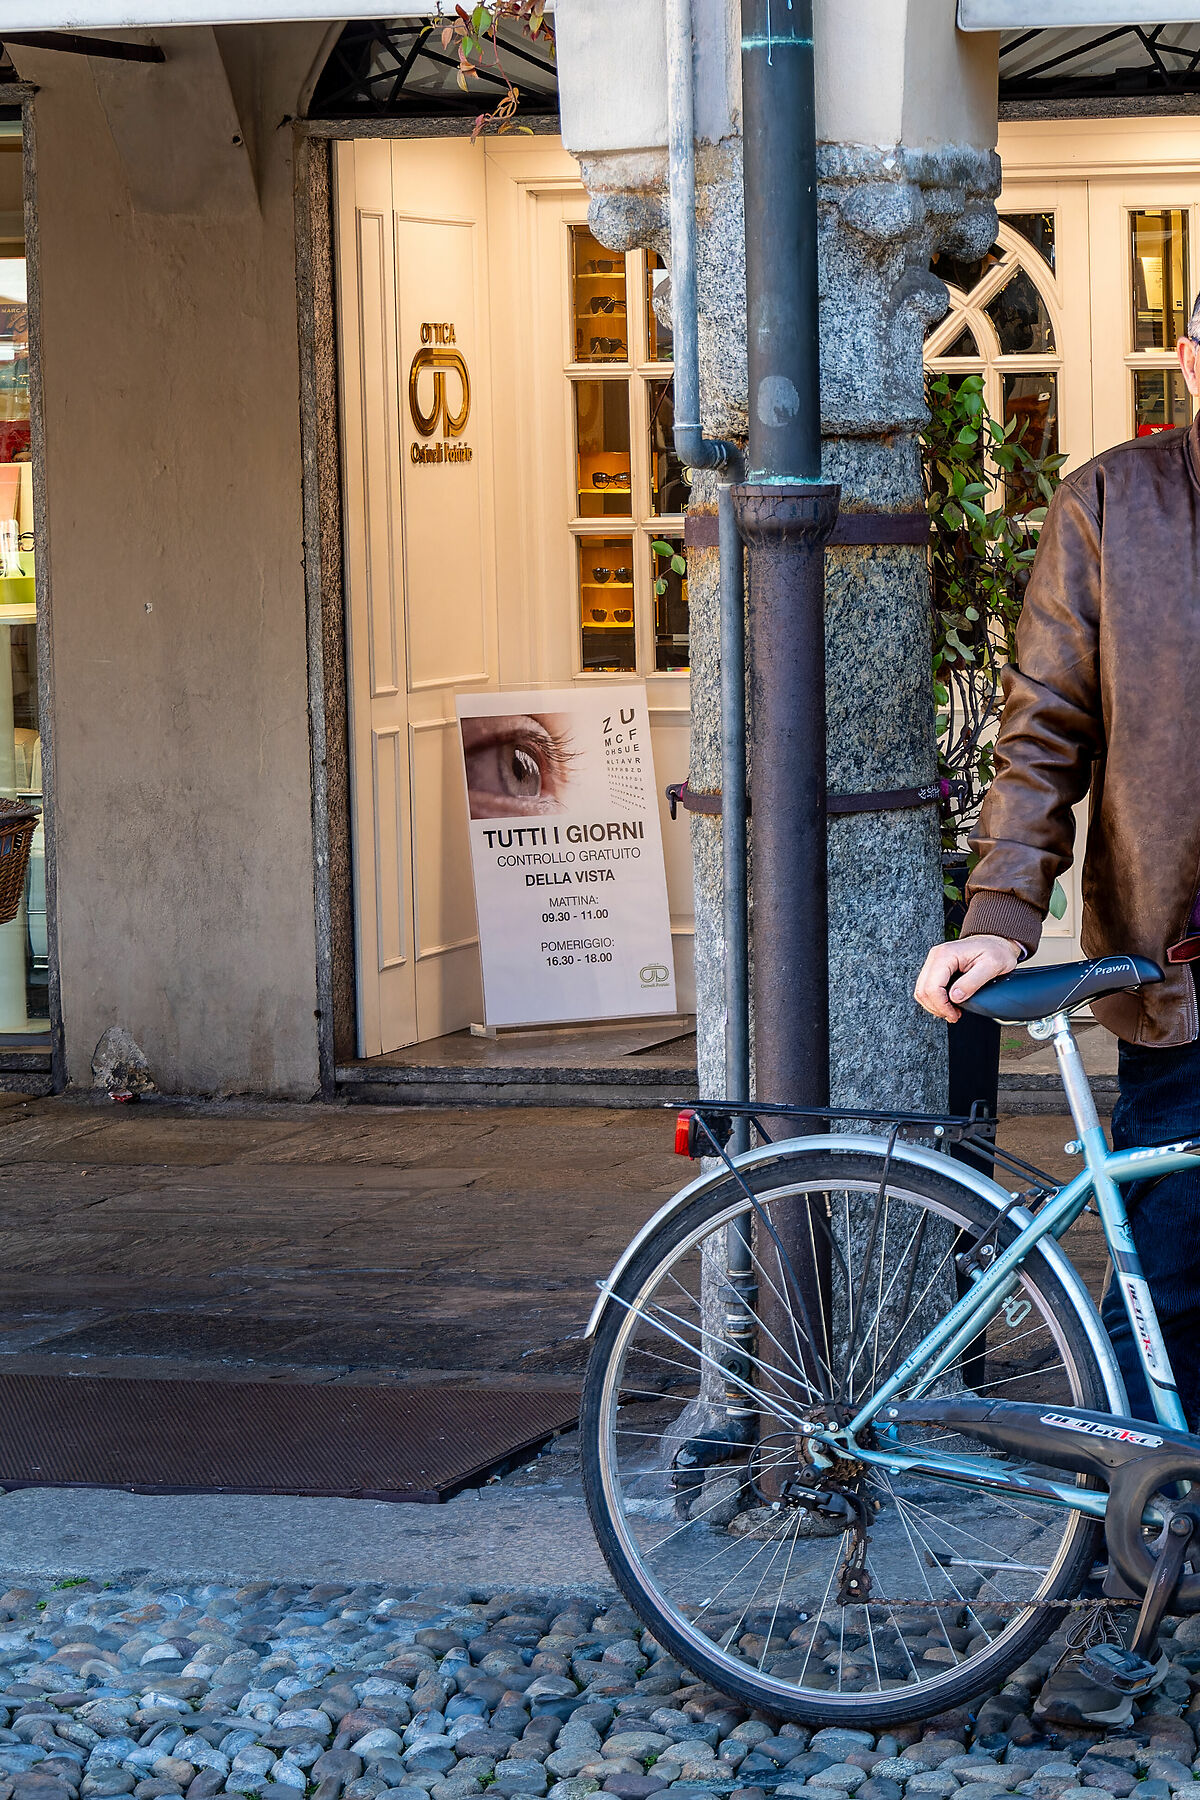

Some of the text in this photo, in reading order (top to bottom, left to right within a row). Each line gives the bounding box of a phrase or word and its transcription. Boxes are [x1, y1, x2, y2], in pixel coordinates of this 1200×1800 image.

[420, 322, 456, 344] OTTICA
[410, 442, 443, 464] Ostinelli
[482, 821, 645, 849] TUTTI I GIORNI
[497, 847, 641, 867] CONTROLLO GRATUITO
[525, 869, 616, 887] DELLA VISTA
[549, 895, 599, 908] MATTINA:
[541, 911, 571, 923] 09.30
[580, 909, 609, 921] 11.00
[541, 937, 615, 952] POMERIGGIO:
[546, 955, 574, 967] 16.30
[584, 952, 612, 964] 18.00
[1095, 964, 1130, 976] Prawn
[920, 1330, 941, 1353] HIGH
[945, 1285, 984, 1326] HOLDING
[986, 1250, 1014, 1281] FRAME
